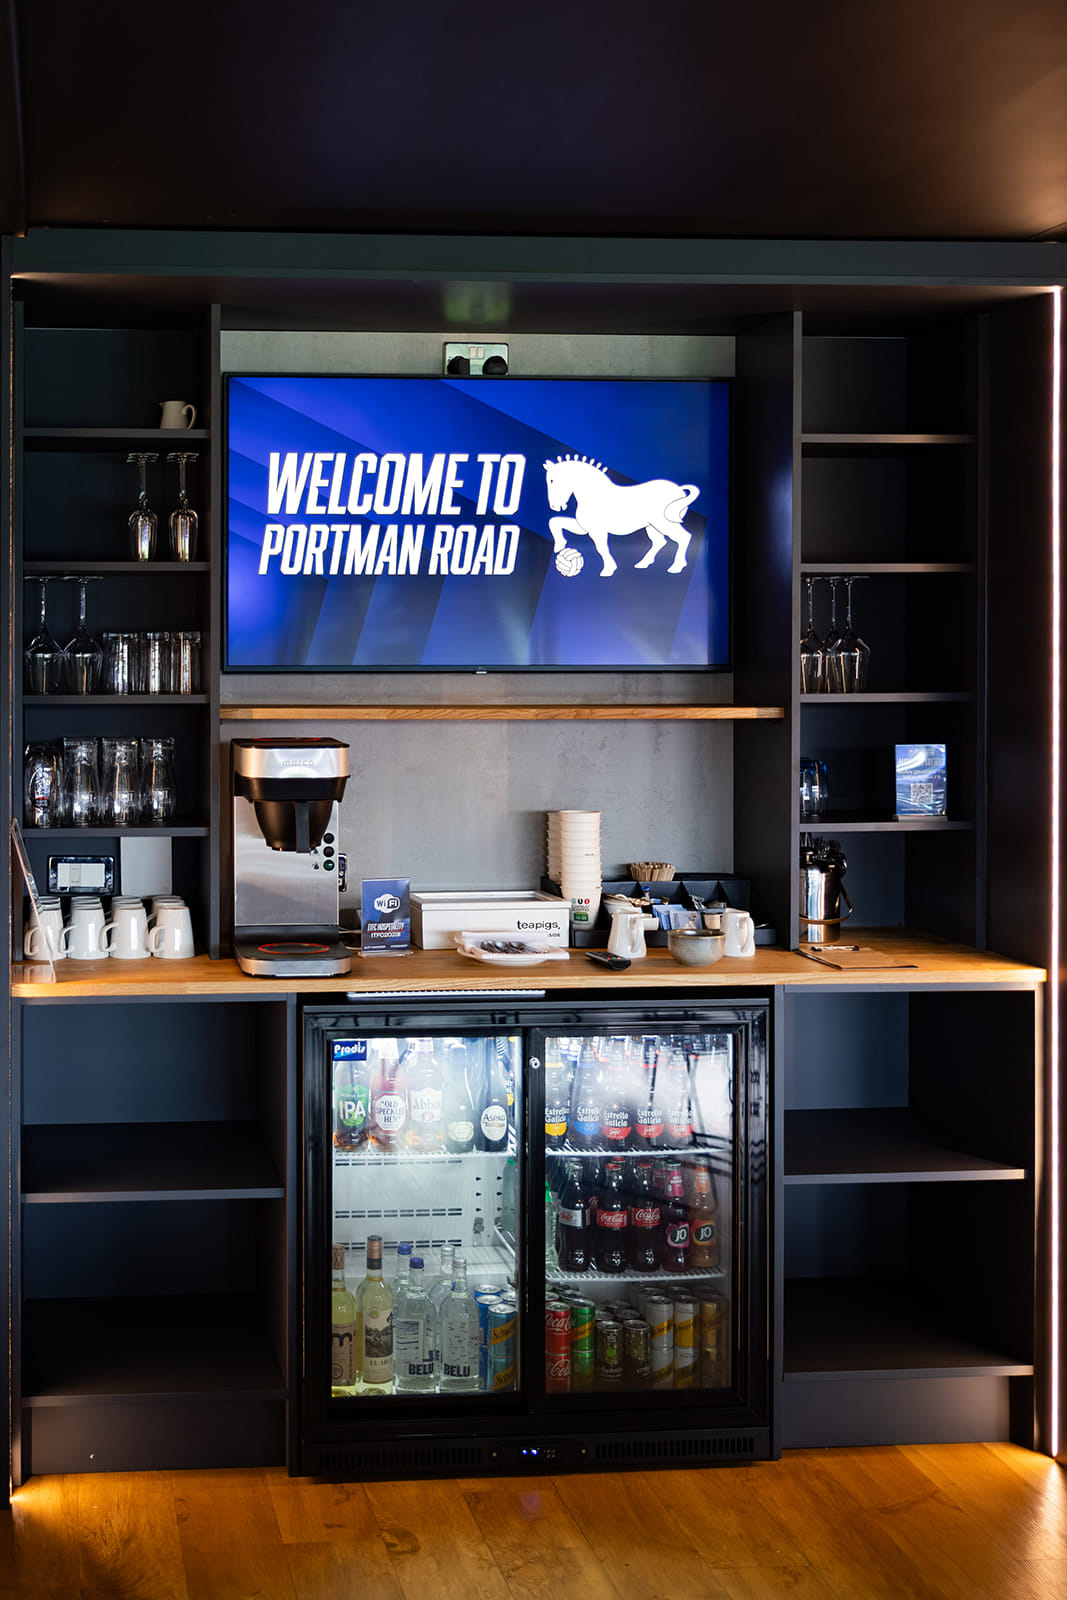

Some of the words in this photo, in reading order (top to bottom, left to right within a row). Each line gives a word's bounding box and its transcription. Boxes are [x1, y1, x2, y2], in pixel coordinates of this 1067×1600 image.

[266, 452, 470, 516] WELCOME
[475, 453, 527, 516] TO
[258, 523, 426, 576] PORTMAN
[428, 524, 520, 576] ROAD
[516, 920, 561, 930] teapigs.
[334, 1041, 366, 1055] Prodis
[338, 1100, 366, 1120] IPA
[408, 1363, 434, 1376] BELU
[443, 1363, 471, 1377] BELU
